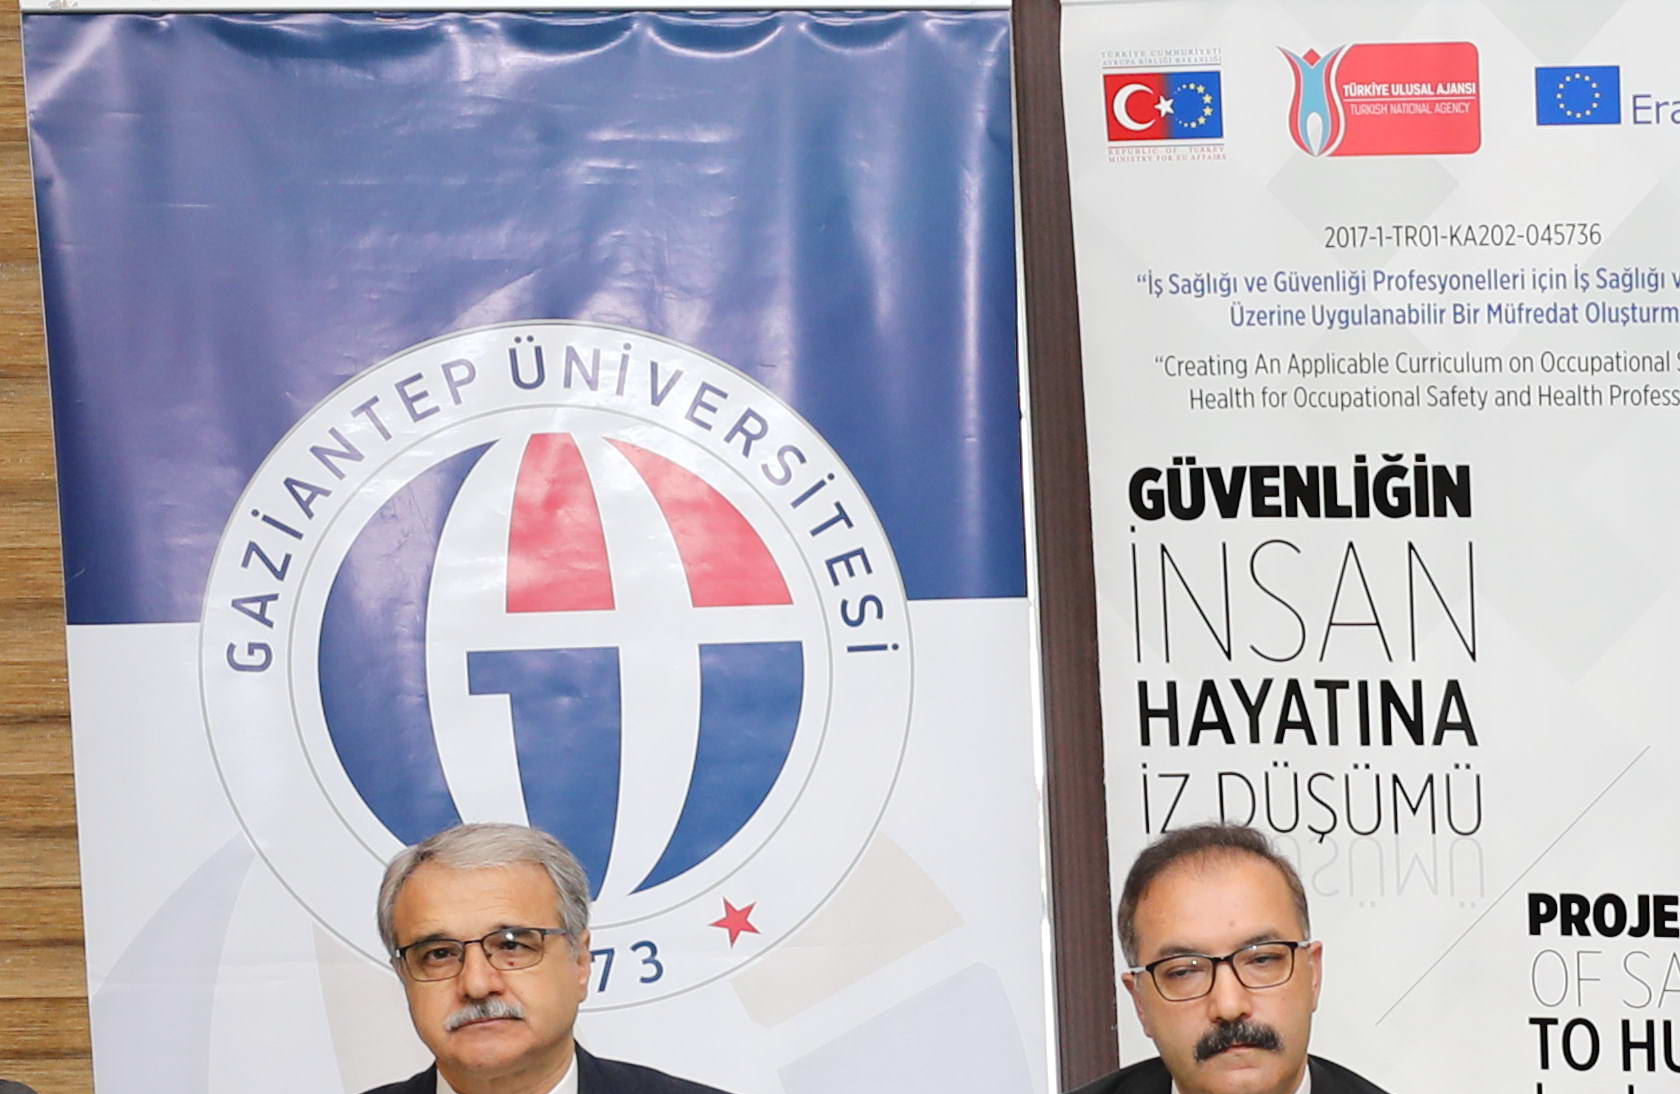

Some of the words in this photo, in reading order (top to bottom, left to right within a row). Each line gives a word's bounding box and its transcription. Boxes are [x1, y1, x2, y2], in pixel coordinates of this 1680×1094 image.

[1343, 81, 1389, 96] TÜRKİYE
[1391, 83, 1434, 96] ULUSAL
[1436, 82, 1476, 95] AJANSI
[1390, 103, 1432, 115] NATIONAL
[1434, 102, 1470, 114] AGENCY
[1324, 223, 1602, 248] 2017-1-TR01-KA202-045736
[1169, 271, 1237, 298] Sağlığı
[1244, 276, 1268, 293] ve
[1274, 270, 1366, 296] Güvenliği
[1374, 268, 1525, 295] Profesyonelleri
[1532, 268, 1567, 293] için
[1574, 264, 1590, 292] İş
[1596, 267, 1665, 293] Sağlığı
[1230, 302, 1306, 327] Üzerine
[1312, 303, 1446, 330] Uygulanabilir
[1452, 303, 1480, 324] Bir
[1487, 302, 1579, 325] Müfredat
[1255, 353, 1281, 376] An
[1288, 353, 1389, 378] Applicable
[1395, 351, 1502, 374] Curriculum
[1509, 356, 1534, 373] on
[1540, 351, 1670, 376] Occupational
[1189, 388, 1255, 410] Health
[1261, 387, 1287, 408] for
[1293, 386, 1420, 411] Occupational
[1426, 386, 1488, 411] Safety
[1495, 386, 1531, 407] and
[1538, 385, 1603, 407] Health
[508, 335, 900, 655] ÜNİVERSİTESİ
[1129, 453, 1472, 522] GÜVENLİĞİN
[227, 358, 478, 673] GAZİANTEP
[1131, 524, 1478, 664] İNSAN
[1139, 677, 1479, 747] HAYATINA
[1142, 763, 1190, 834] İZ
[1218, 761, 1483, 844] DÜŞÜMÜ
[589, 940, 664, 992] 73
[1532, 949, 1603, 1008] OF
[1528, 1017, 1600, 1072] TO
